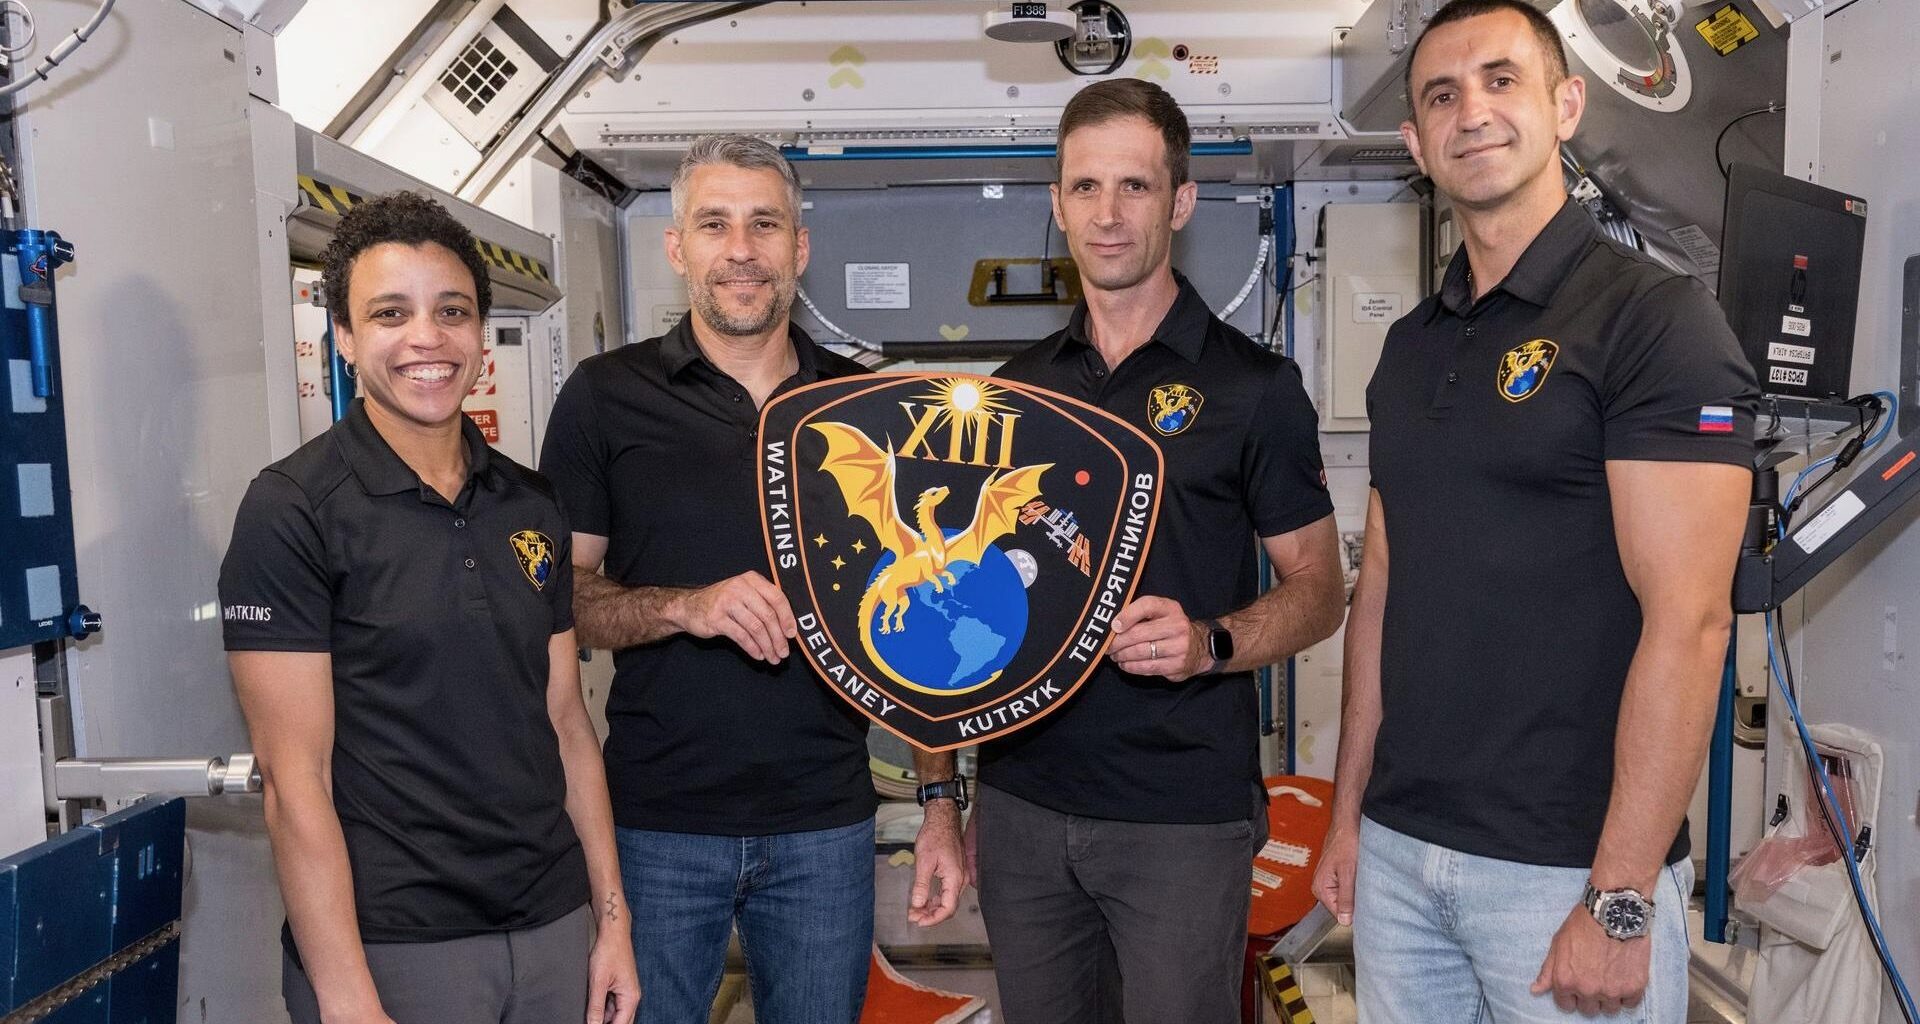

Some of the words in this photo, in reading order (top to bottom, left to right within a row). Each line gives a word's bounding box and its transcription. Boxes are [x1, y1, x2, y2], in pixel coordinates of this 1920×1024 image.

[1013, 5, 1023, 16] FI
[1026, 5, 1045, 16] 388
[896, 401, 1022, 469] XIII
[766, 440, 798, 569] WATKINS
[1068, 473, 1153, 664] ТЕТЕРЯТНИКОВ
[224, 605, 272, 621] WATKINS
[798, 613, 897, 719] DELANEY
[958, 679, 1062, 738] KUTRYK
